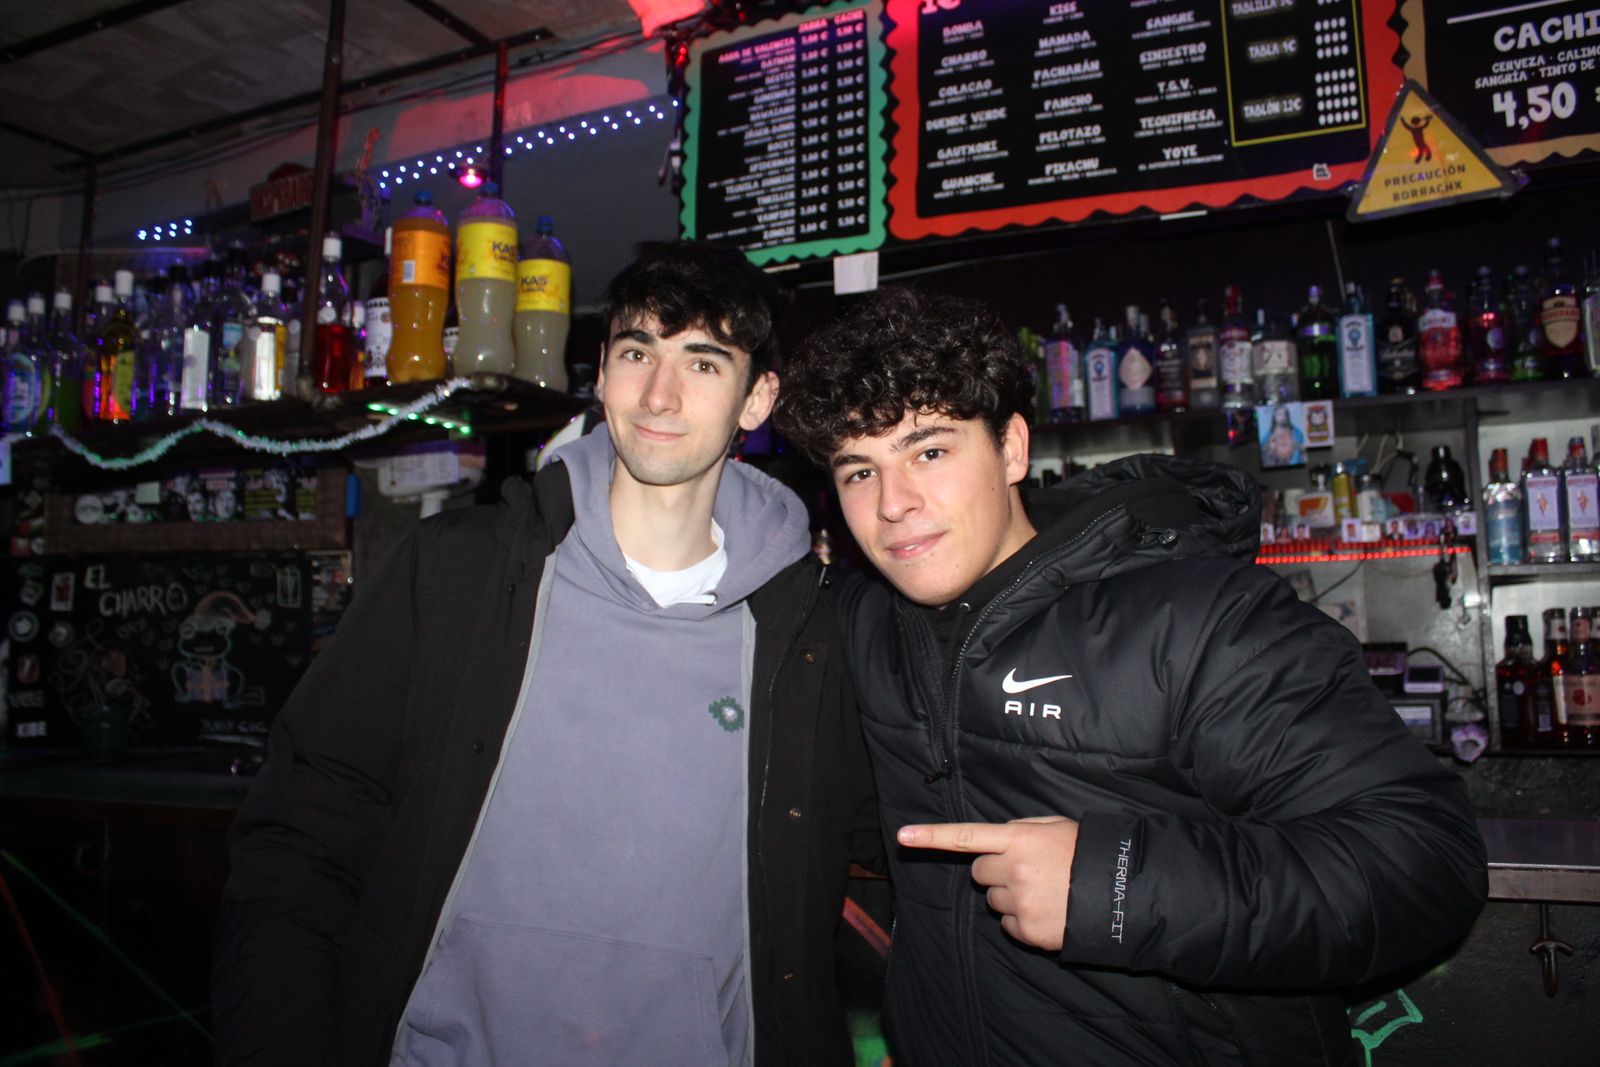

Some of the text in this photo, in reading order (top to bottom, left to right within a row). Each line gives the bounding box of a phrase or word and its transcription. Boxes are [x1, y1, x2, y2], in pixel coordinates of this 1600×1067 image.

[1146, 11, 1195, 30] SANGRE
[1039, 30, 1091, 49] MAMADA
[941, 49, 988, 68] CHARRO
[1139, 42, 1207, 64] SINIESTRO
[1034, 59, 1100, 82] PACHARÁN
[1475, 59, 1595, 89] SANGRÍA TINTO DE
[1492, 55, 1545, 73] CERVEZA
[938, 79, 992, 99] COLACAO
[1044, 93, 1093, 112] PANCHO
[1492, 81, 1576, 130] 4,50
[1139, 108, 1216, 129] TEQUIFRESA
[1039, 125, 1102, 144] PELOTAZO
[1162, 144, 1198, 160] YOYE
[1045, 158, 1100, 177] PIKACHU
[1385, 164, 1466, 188] PRECAUCIÓN
[1393, 181, 1462, 202] BORRACHX
[520, 275, 548, 287] KAS
[83, 563, 112, 590] EL
[98, 581, 189, 618] CHARRO
[1004, 700, 1062, 720] AIR
[1111, 839, 1131, 944] THERMA-FIT
